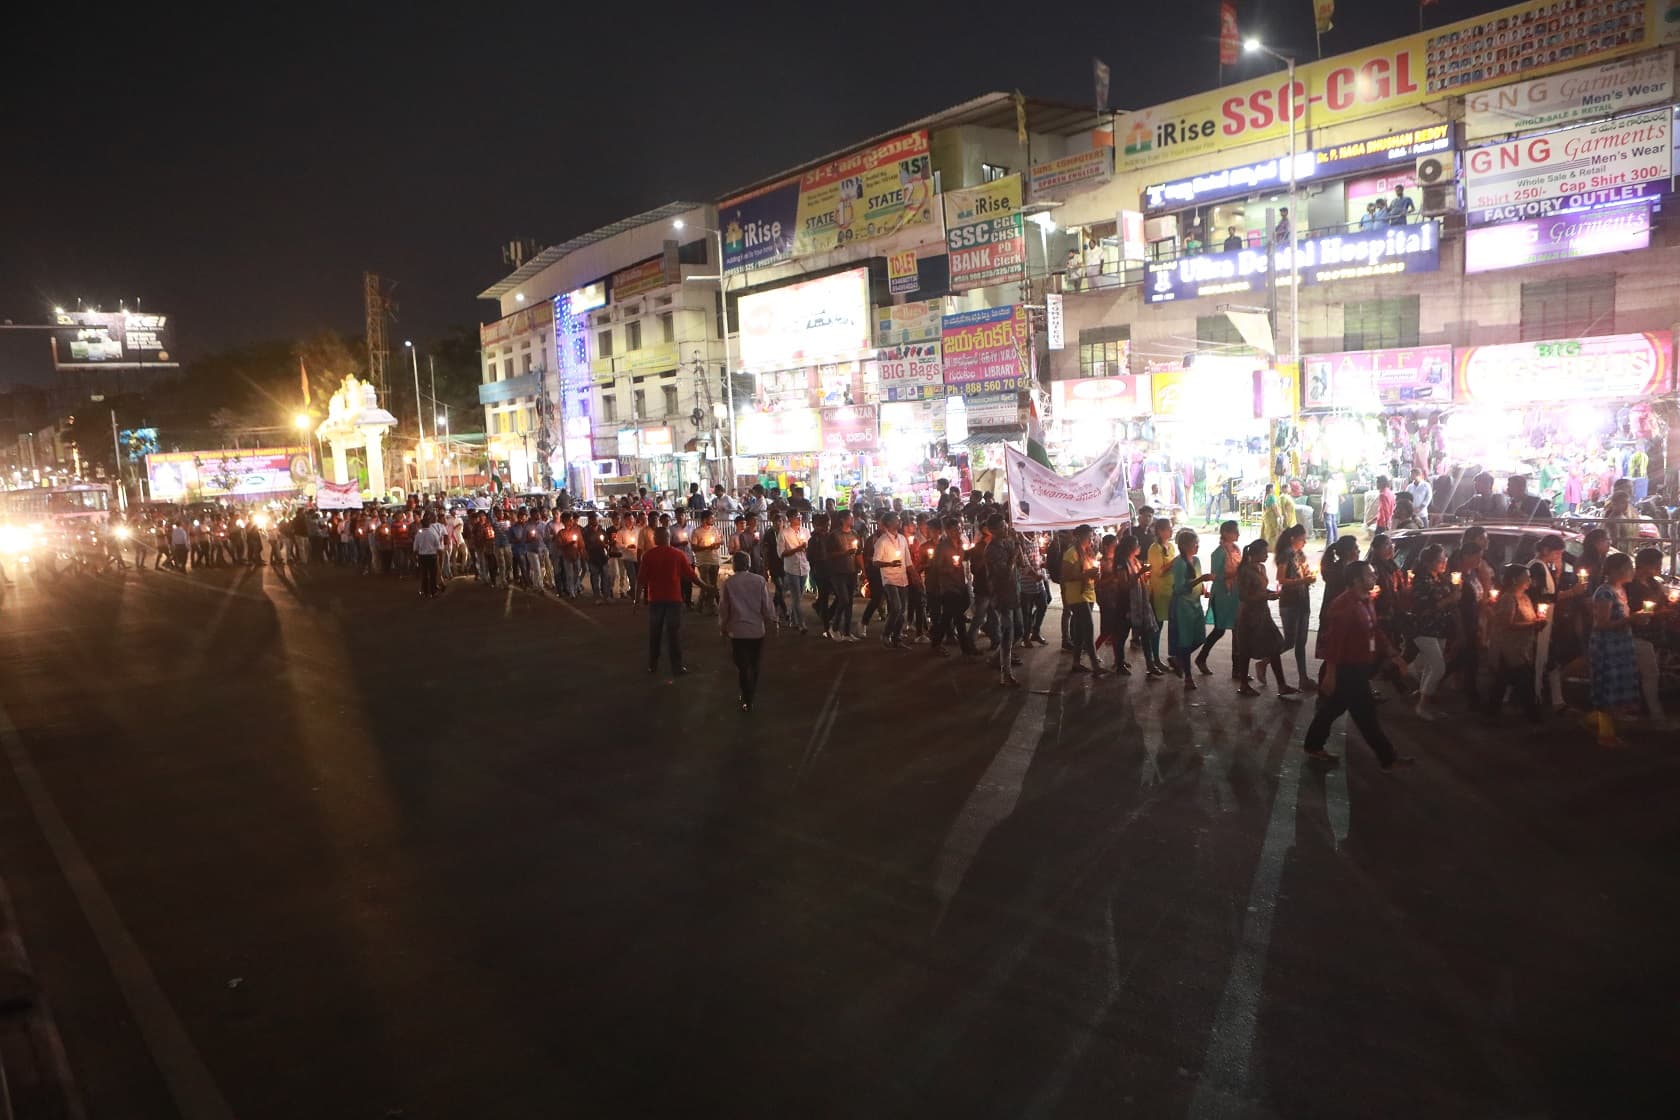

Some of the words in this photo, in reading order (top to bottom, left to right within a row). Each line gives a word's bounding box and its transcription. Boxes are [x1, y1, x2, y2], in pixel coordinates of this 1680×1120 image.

[1560, 62, 1669, 99] Garments
[1582, 89, 1623, 106] Men's
[1627, 82, 1666, 97] Wear
[1581, 103, 1613, 117] RETAIL
[1157, 118, 1216, 149] iRise
[1564, 124, 1667, 160] Garments
[1339, 143, 1365, 160] NAGA
[1591, 151, 1628, 165] Men's
[1632, 144, 1666, 158] Wear
[1478, 193, 1510, 207] Shirt
[1514, 186, 1547, 202] 250/-
[1559, 180, 1587, 195] Cap
[1591, 170, 1627, 188] Shirt
[1631, 165, 1668, 181] 300/-
[1517, 175, 1546, 188] Whole
[1547, 172, 1568, 183] Sale
[1569, 170, 1577, 179] &
[1579, 165, 1607, 177] Retail
[868, 189, 904, 210] STATE
[1484, 198, 1563, 223] FACTORY
[1568, 183, 1648, 207] OUTLET
[805, 211, 835, 230] STATE
[993, 215, 1016, 229] CGL
[1549, 211, 1648, 244] Garments
[744, 219, 782, 249] iRise
[949, 223, 991, 250] SSC
[991, 227, 1022, 243] CHSL
[1319, 223, 1432, 266] Hospital
[952, 247, 991, 273] BANK
[993, 253, 1022, 268] Clerk
[1534, 340, 1583, 359] BIG
[881, 363, 905, 380] BIG
[909, 361, 940, 381] Bags
[984, 363, 1016, 378] LIBRARY
[965, 381, 982, 393] 888
[984, 379, 1001, 391] 560
[1003, 378, 1015, 389] 70
